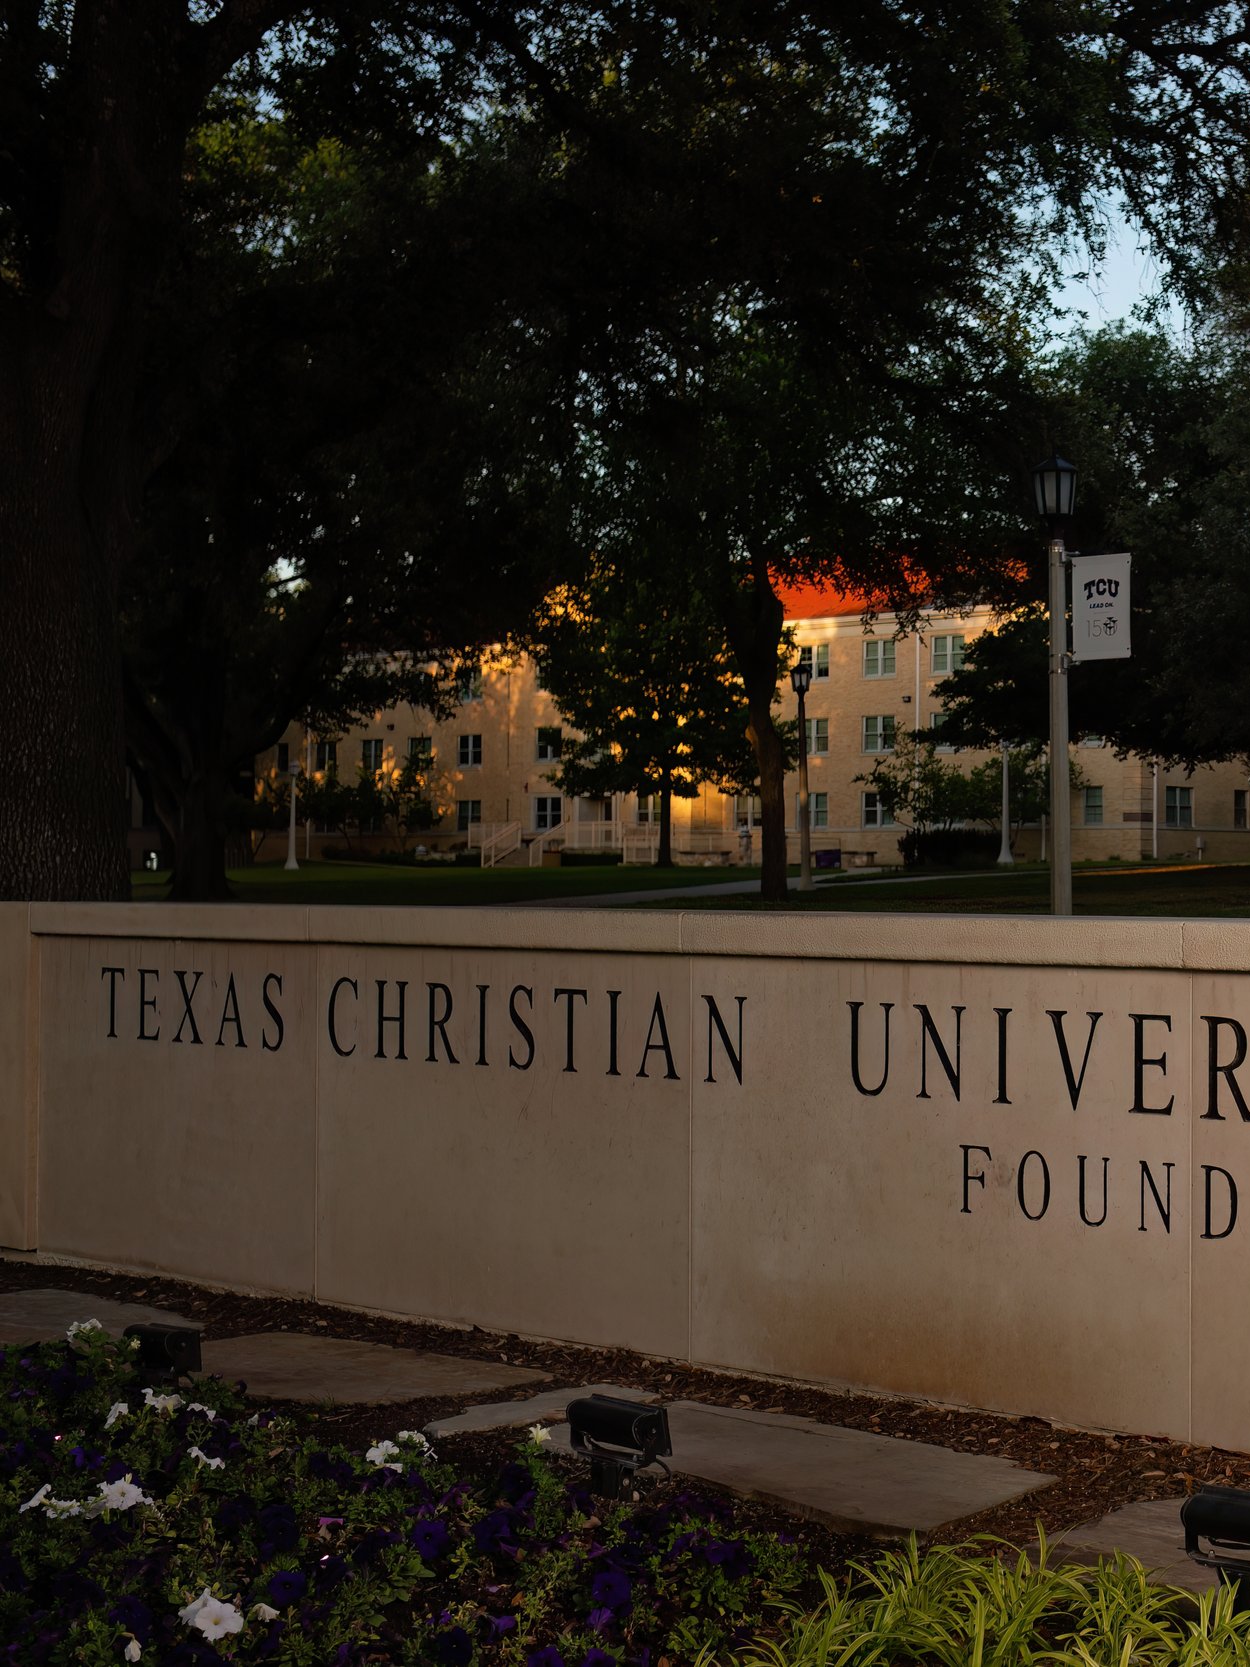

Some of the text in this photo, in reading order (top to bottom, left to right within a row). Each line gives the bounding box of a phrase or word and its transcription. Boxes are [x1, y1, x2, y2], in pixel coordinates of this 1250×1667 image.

[1083, 578, 1120, 600] TCU
[101, 966, 285, 1052] TEXAS
[327, 976, 748, 1086] CHRISTIAN
